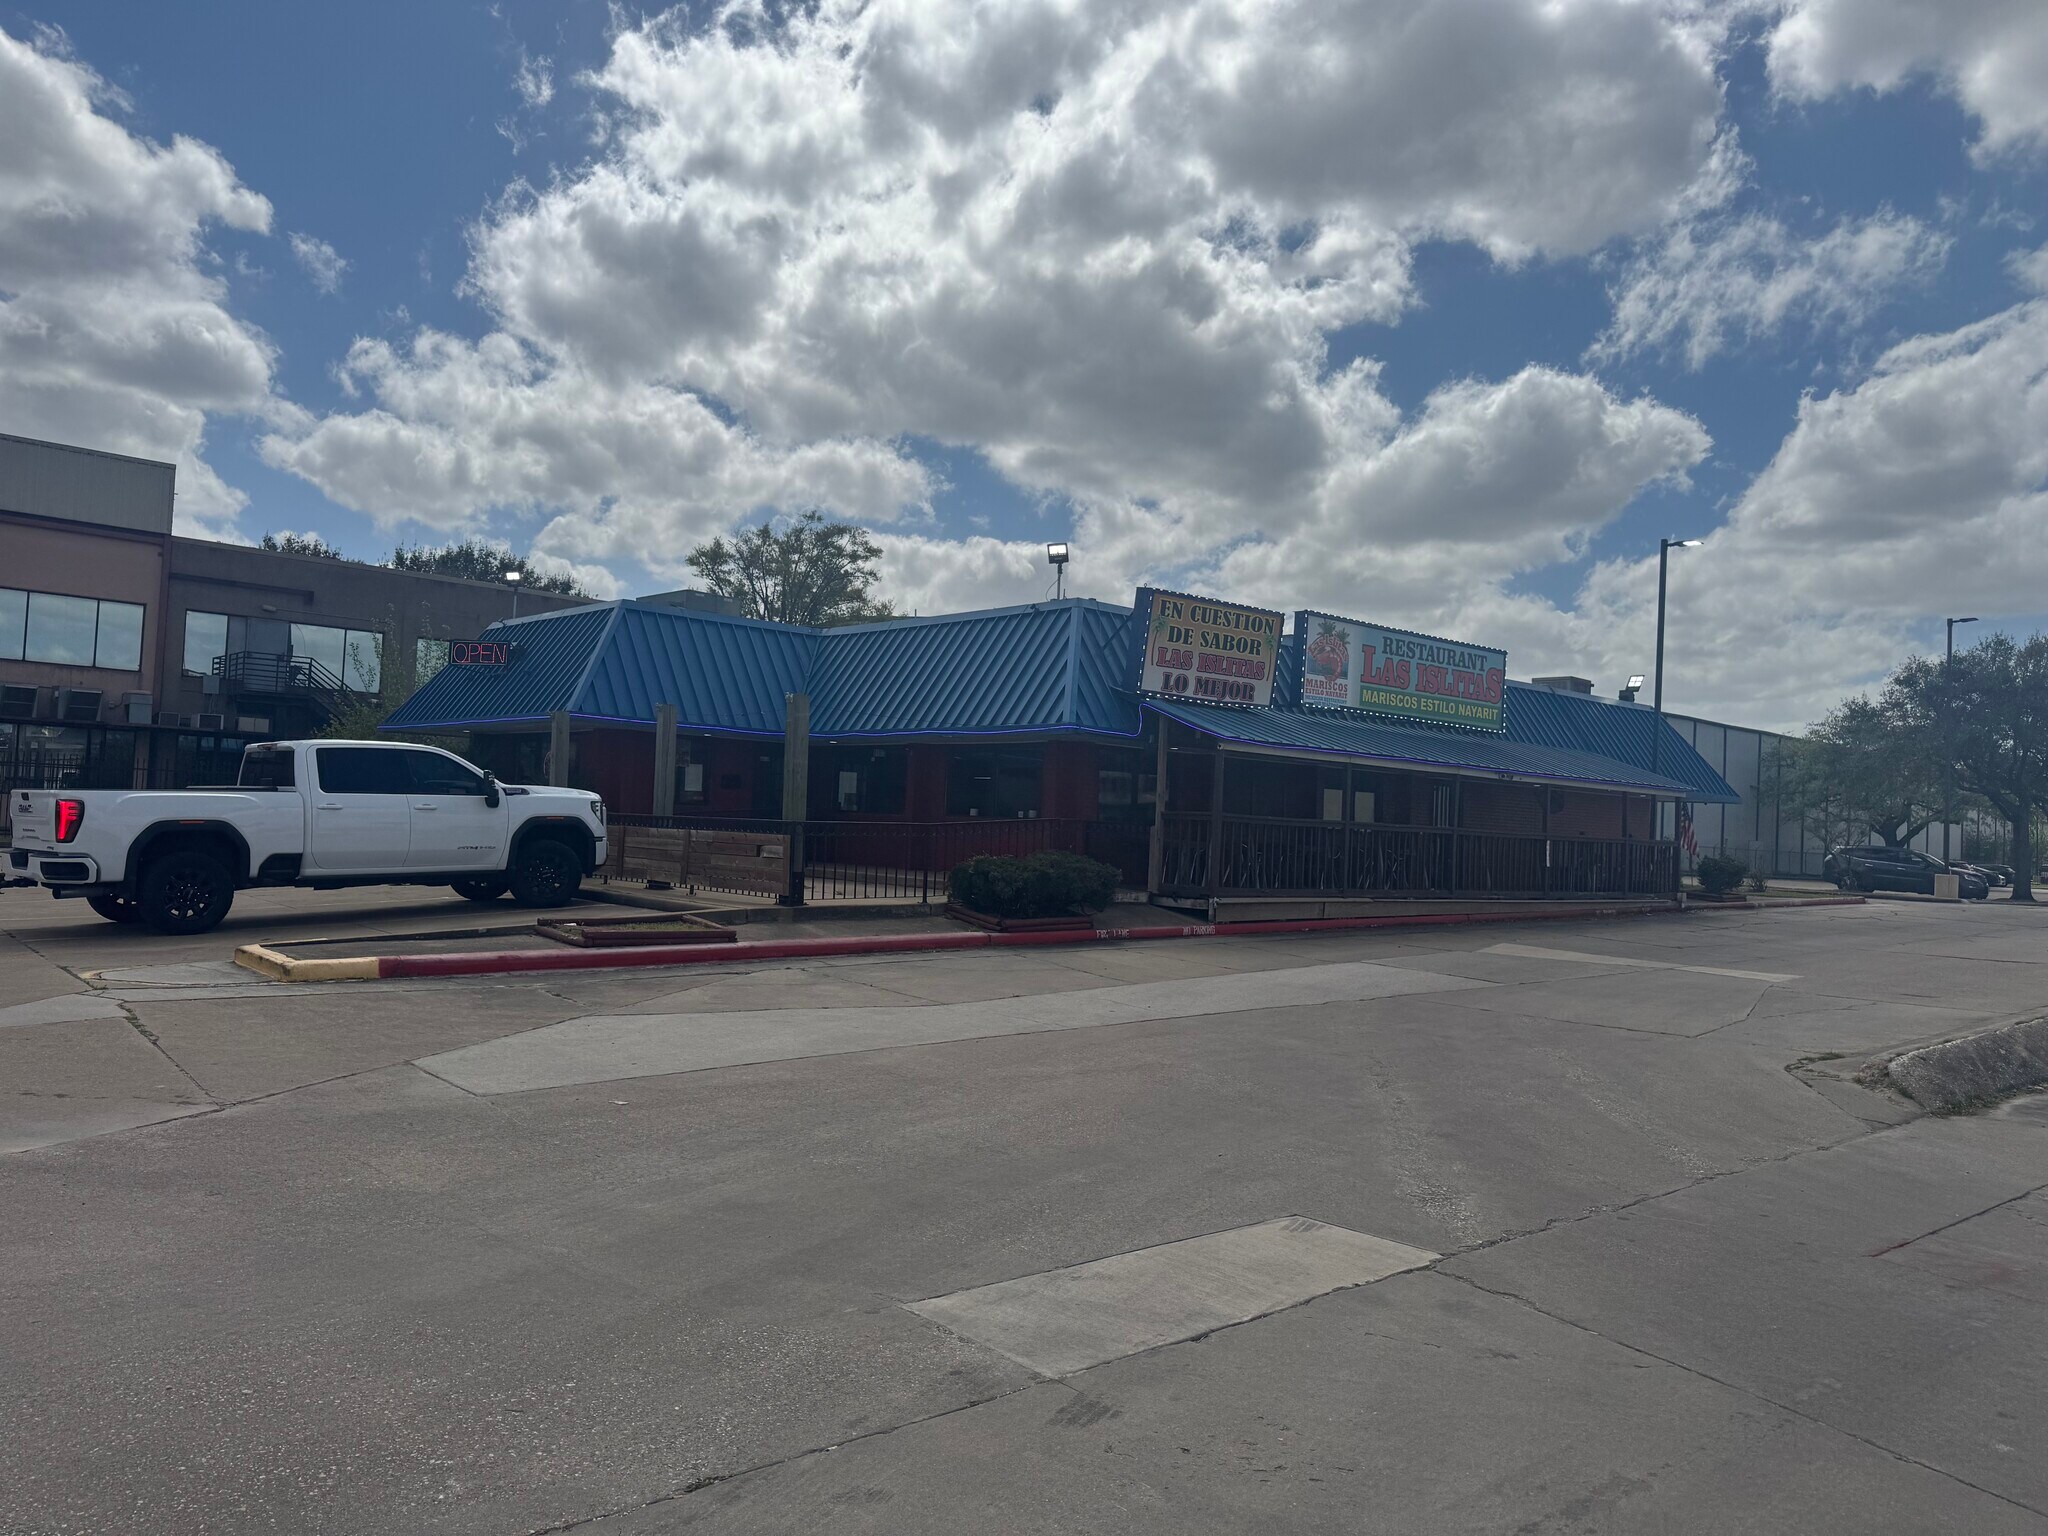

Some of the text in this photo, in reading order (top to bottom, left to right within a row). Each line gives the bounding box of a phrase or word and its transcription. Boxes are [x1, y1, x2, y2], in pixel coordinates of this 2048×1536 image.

[1160, 600, 1275, 634] EN CUESTION
[453, 643, 507, 663] OPEN
[1167, 626, 1262, 656] DE SABOR
[1382, 636, 1487, 672] RESTAURANT
[1156, 647, 1266, 680] LAS ISLITAS
[1360, 644, 1503, 704] LAS ISLITAS
[1161, 671, 1256, 702] LO MEJOR
[1305, 678, 1348, 693] MARISCOS
[1363, 690, 1418, 709] MARISCOS
[1421, 698, 1456, 714] ESTILO
[1459, 704, 1499, 721] NAYARIT
[1194, 924, 1216, 935] PARKING
